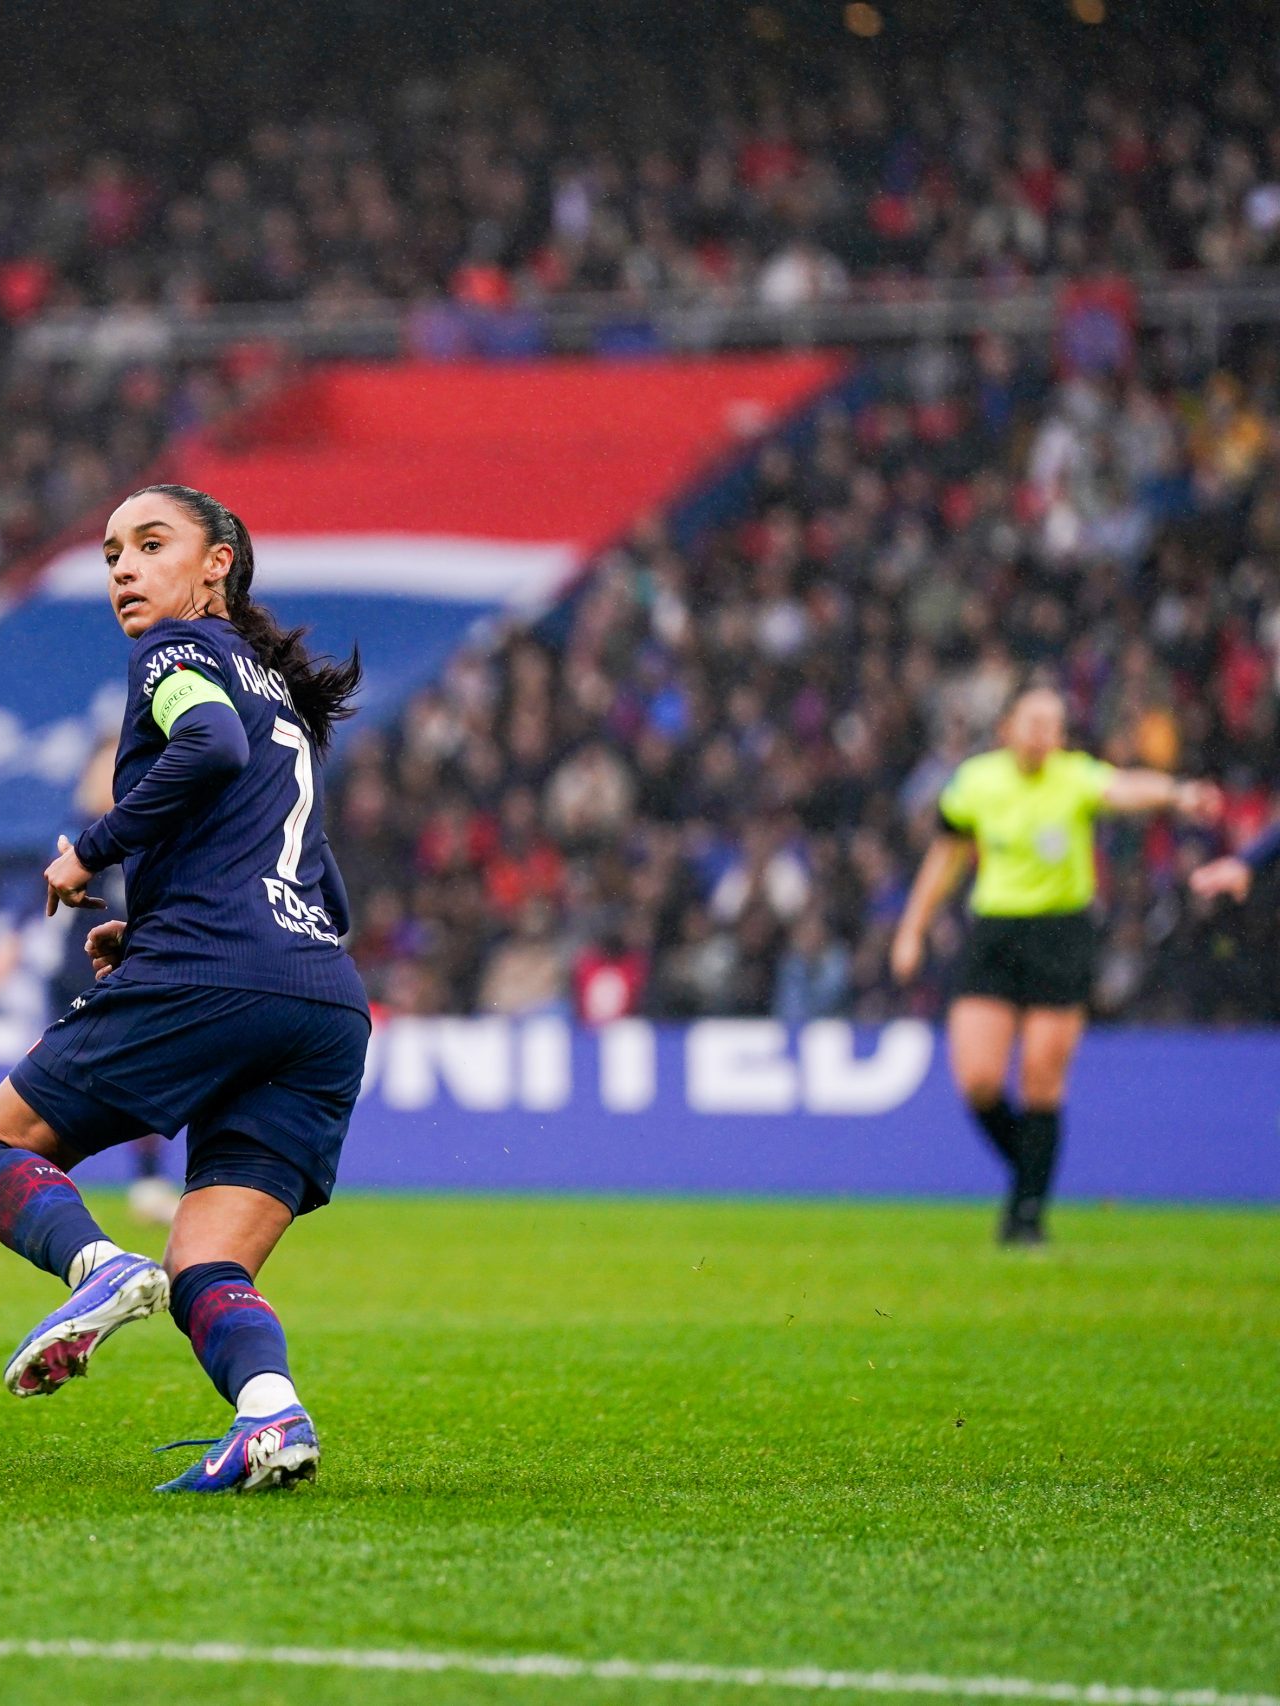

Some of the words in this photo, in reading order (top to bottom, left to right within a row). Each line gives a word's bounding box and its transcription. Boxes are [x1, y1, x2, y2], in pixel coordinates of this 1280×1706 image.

[146, 644, 195, 670] VISIT
[271, 715, 315, 885] 7
[361, 1015, 934, 1116] NITED
